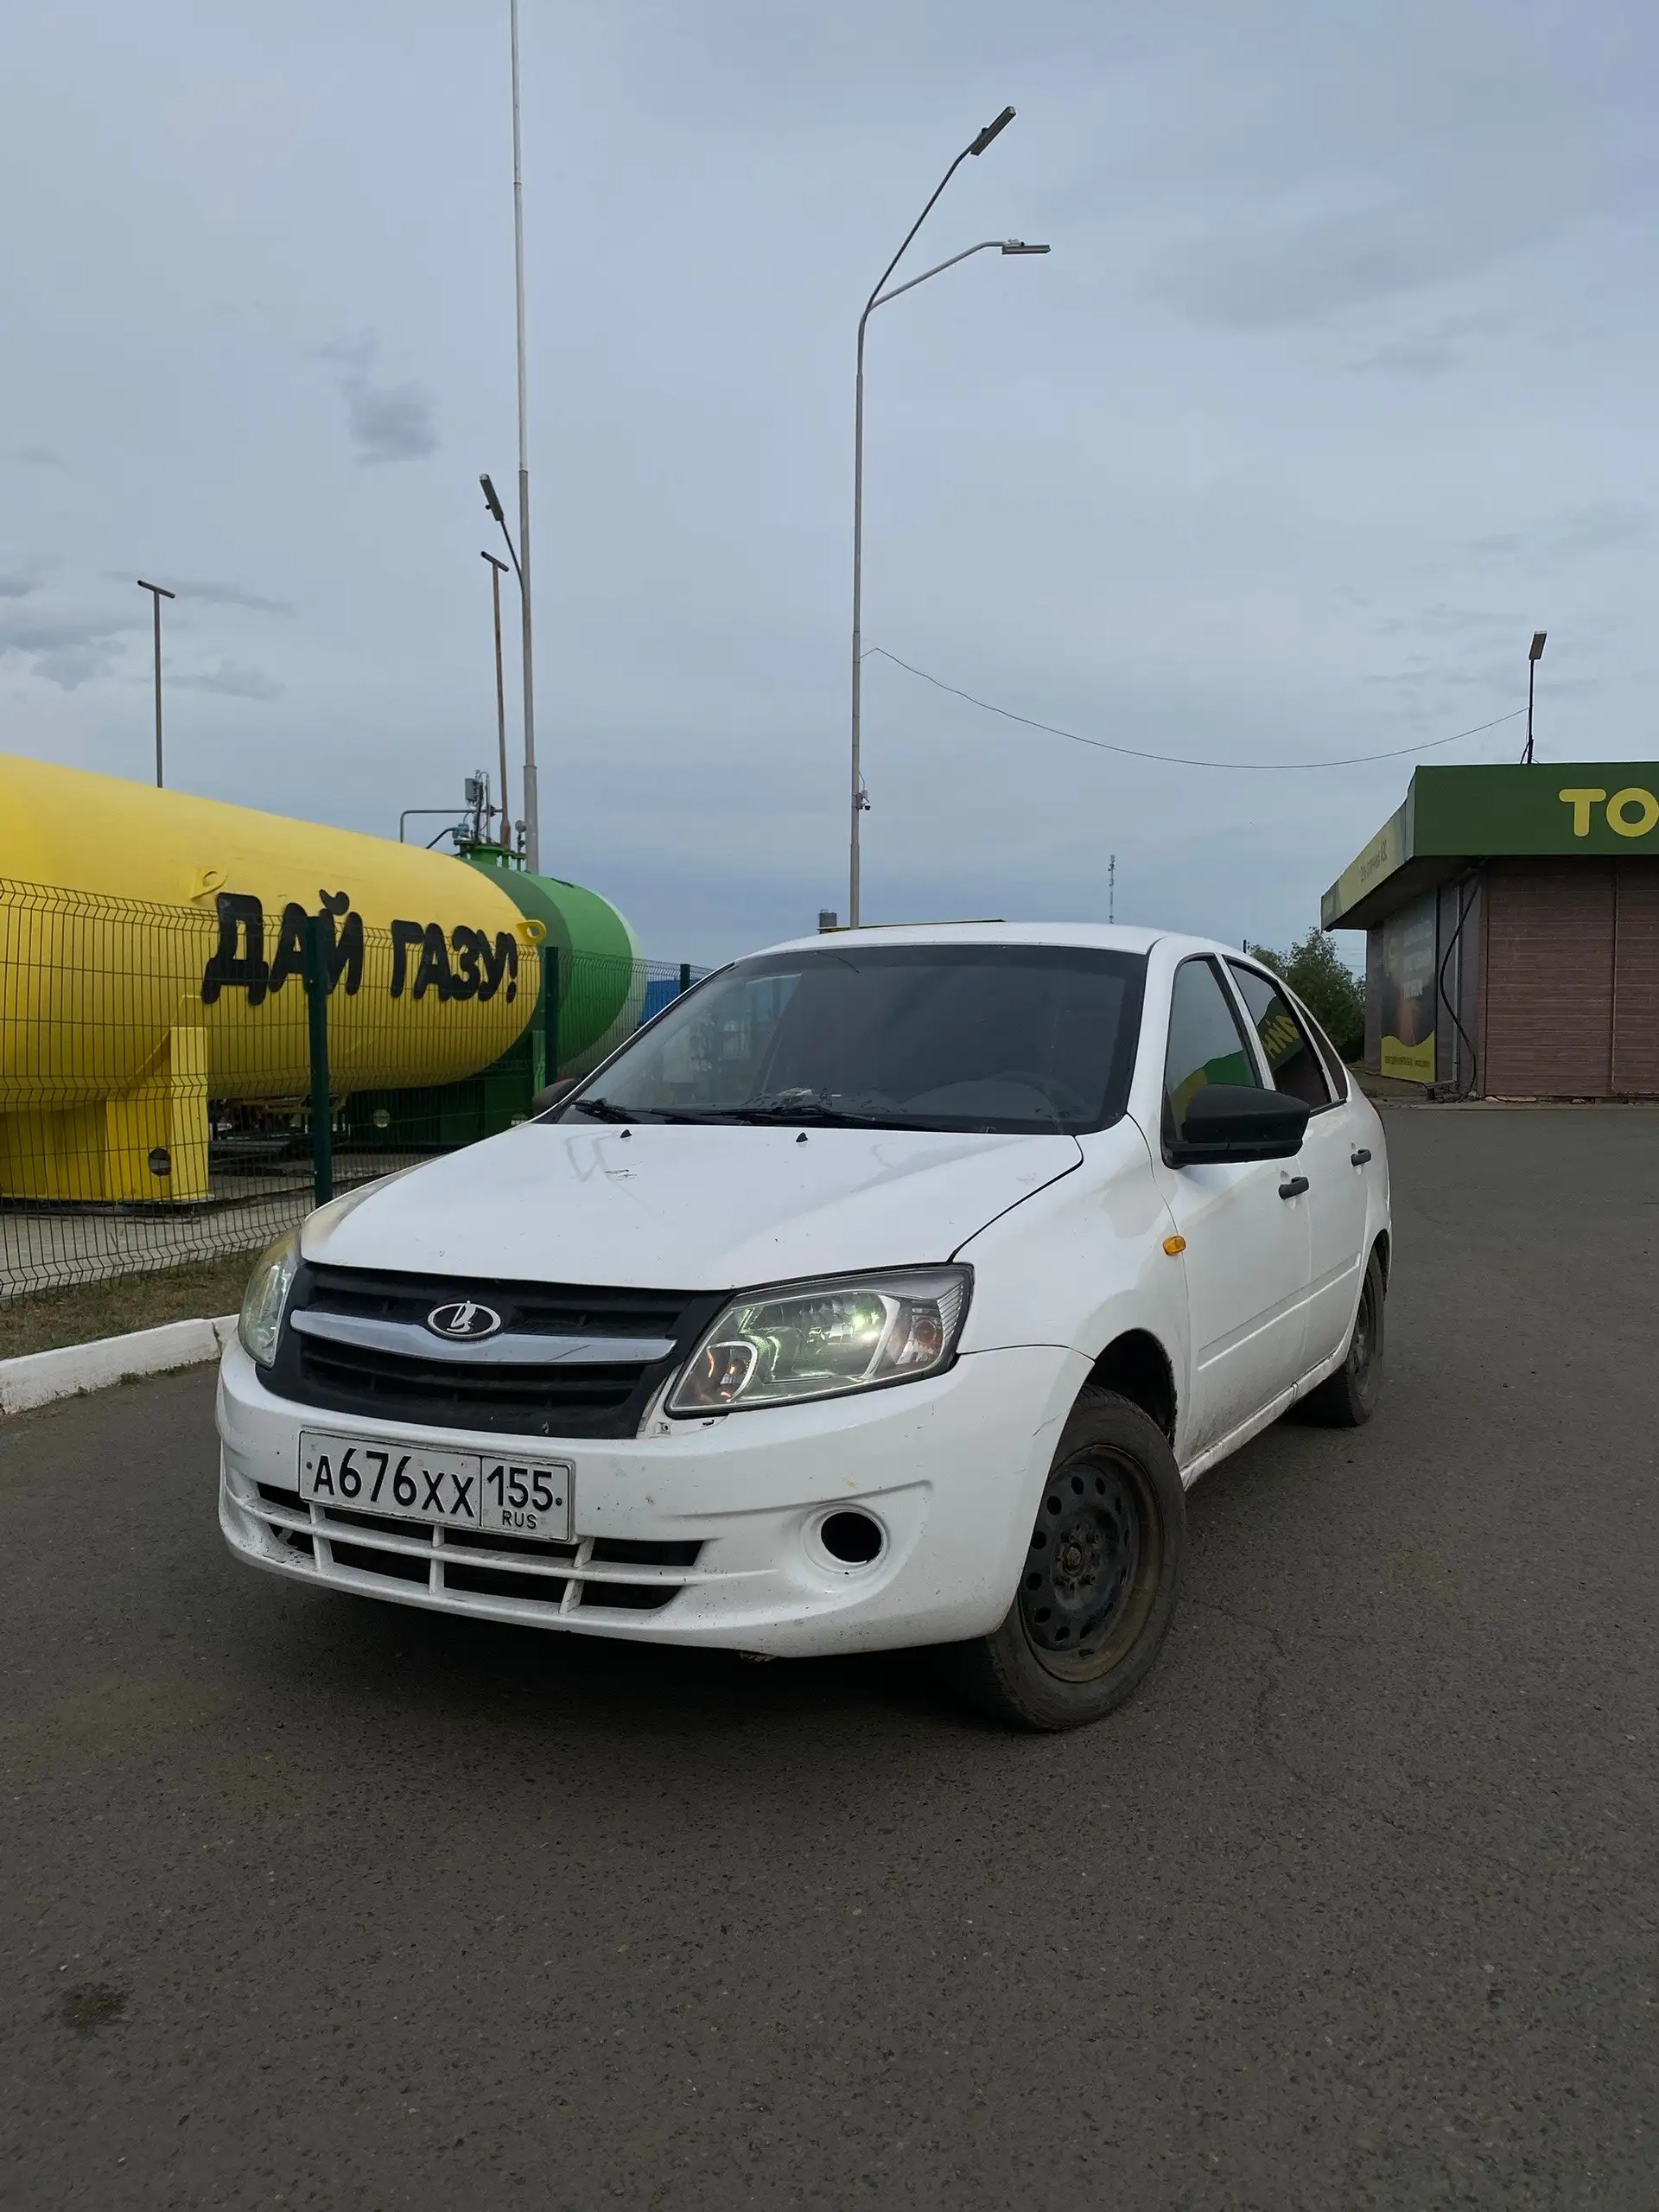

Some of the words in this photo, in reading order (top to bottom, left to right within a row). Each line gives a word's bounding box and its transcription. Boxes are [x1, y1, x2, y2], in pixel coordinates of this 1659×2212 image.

[1559, 787, 1659, 836] ТО
[201, 889, 364, 1006] ДАЙ
[390, 919, 518, 1003] ГАЗУ!
[314, 1448, 474, 1517] А676ХХ
[487, 1465, 553, 1511] 155
[502, 1510, 537, 1529] RUS
